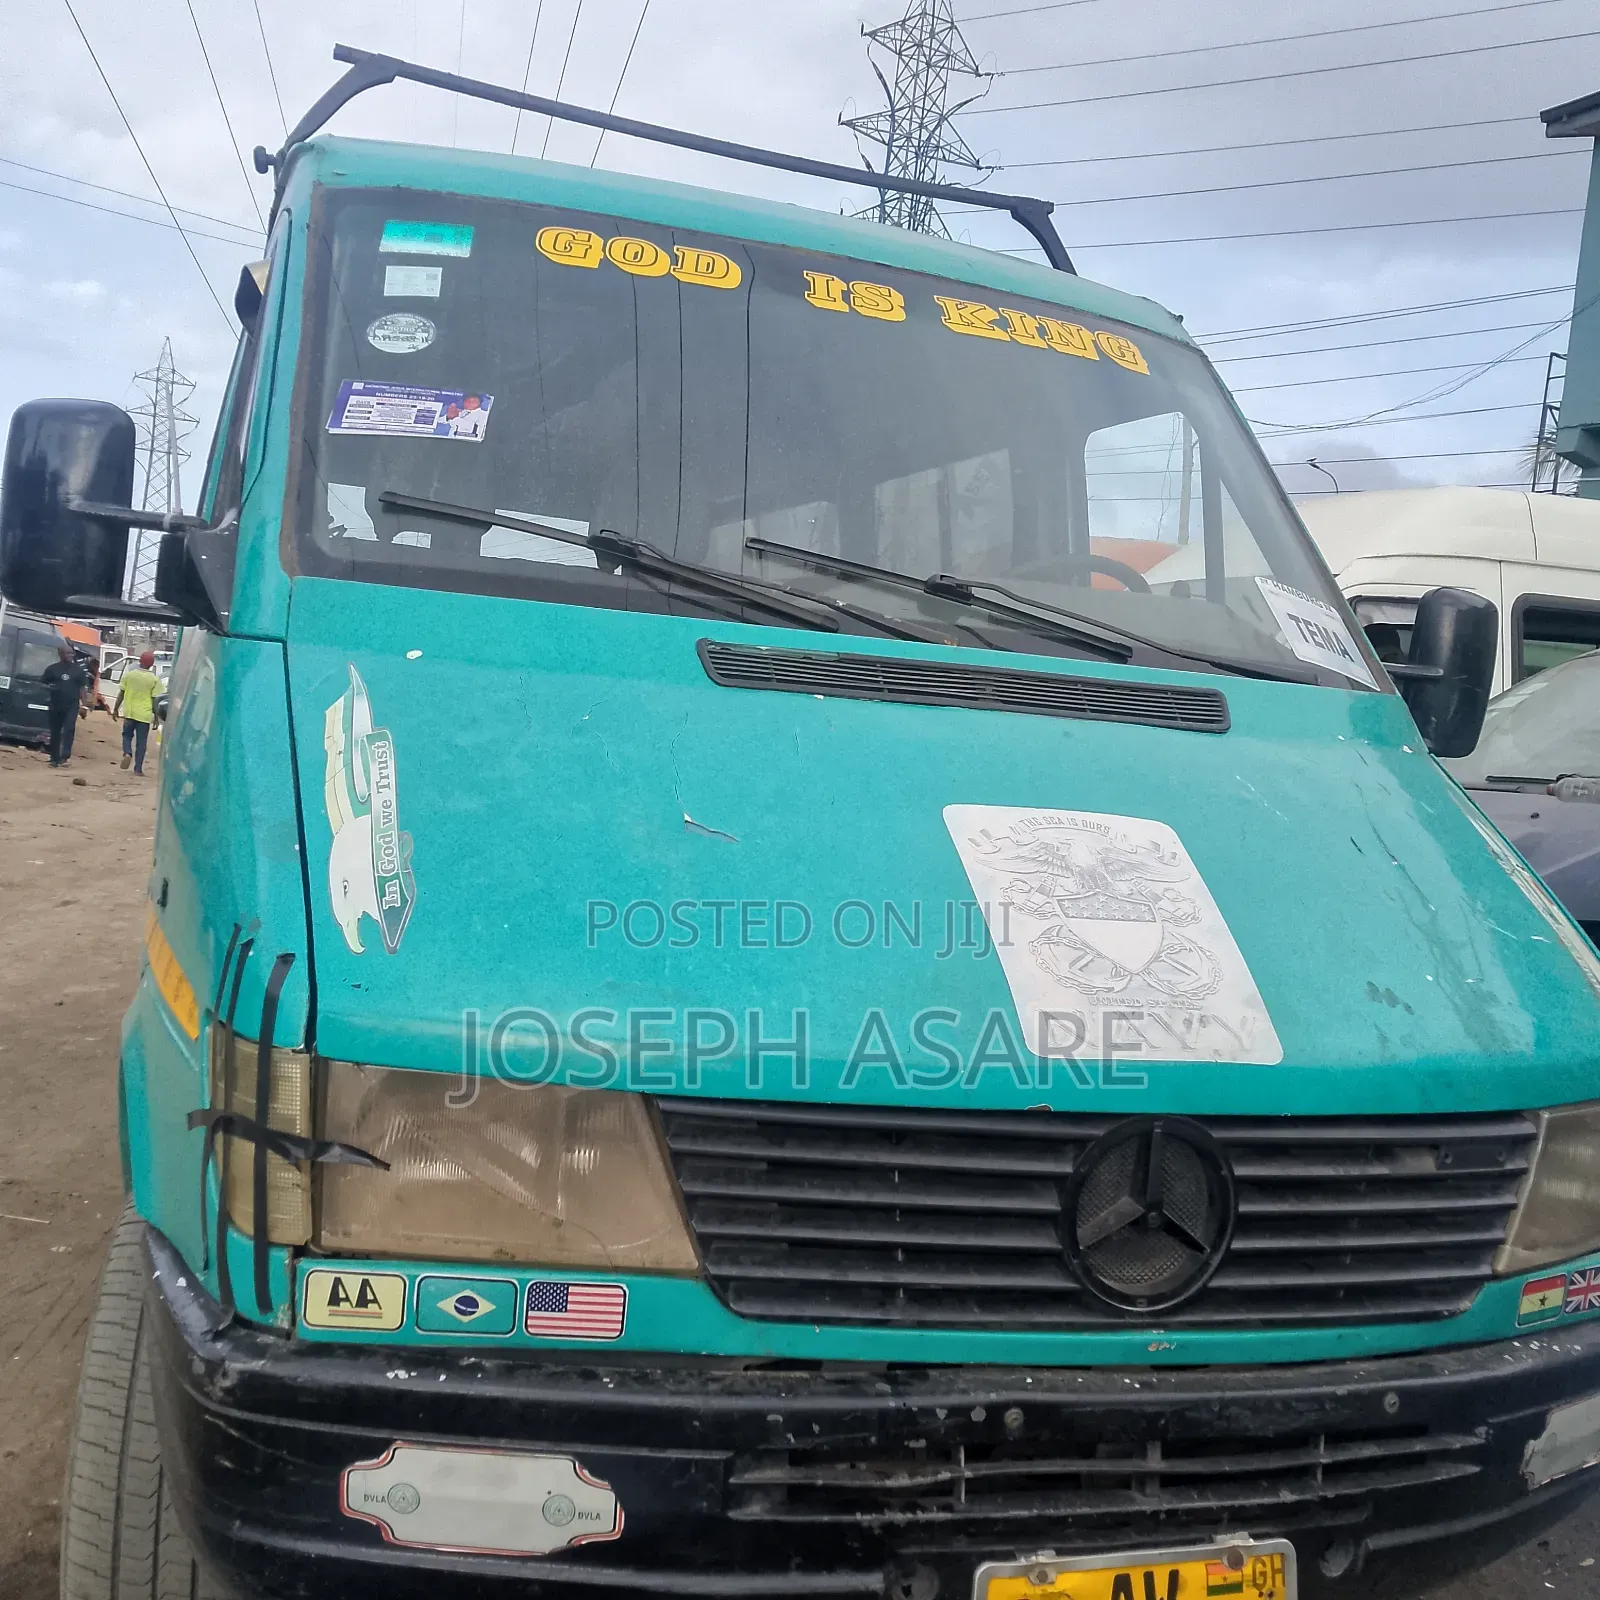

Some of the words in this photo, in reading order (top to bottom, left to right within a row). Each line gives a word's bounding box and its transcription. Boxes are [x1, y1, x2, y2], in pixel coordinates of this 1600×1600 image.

[535, 226, 742, 289] GOD
[803, 270, 906, 322] IS
[934, 295, 1151, 375] KING
[1286, 612, 1355, 662] TEMA
[372, 740, 392, 795] Trust
[382, 799, 397, 829] we
[1018, 817, 1043, 829] THE
[1042, 816, 1065, 826] SEA
[1066, 817, 1079, 827] IS
[1081, 819, 1111, 834] OURS
[375, 832, 397, 876] God
[383, 879, 401, 909] In
[1087, 996, 1144, 1008] UNITED
[326, 1276, 383, 1310] AA
[363, 1494, 387, 1504] DVLA
[577, 1511, 602, 1521] DVLA
[1252, 1552, 1287, 1591] GH
